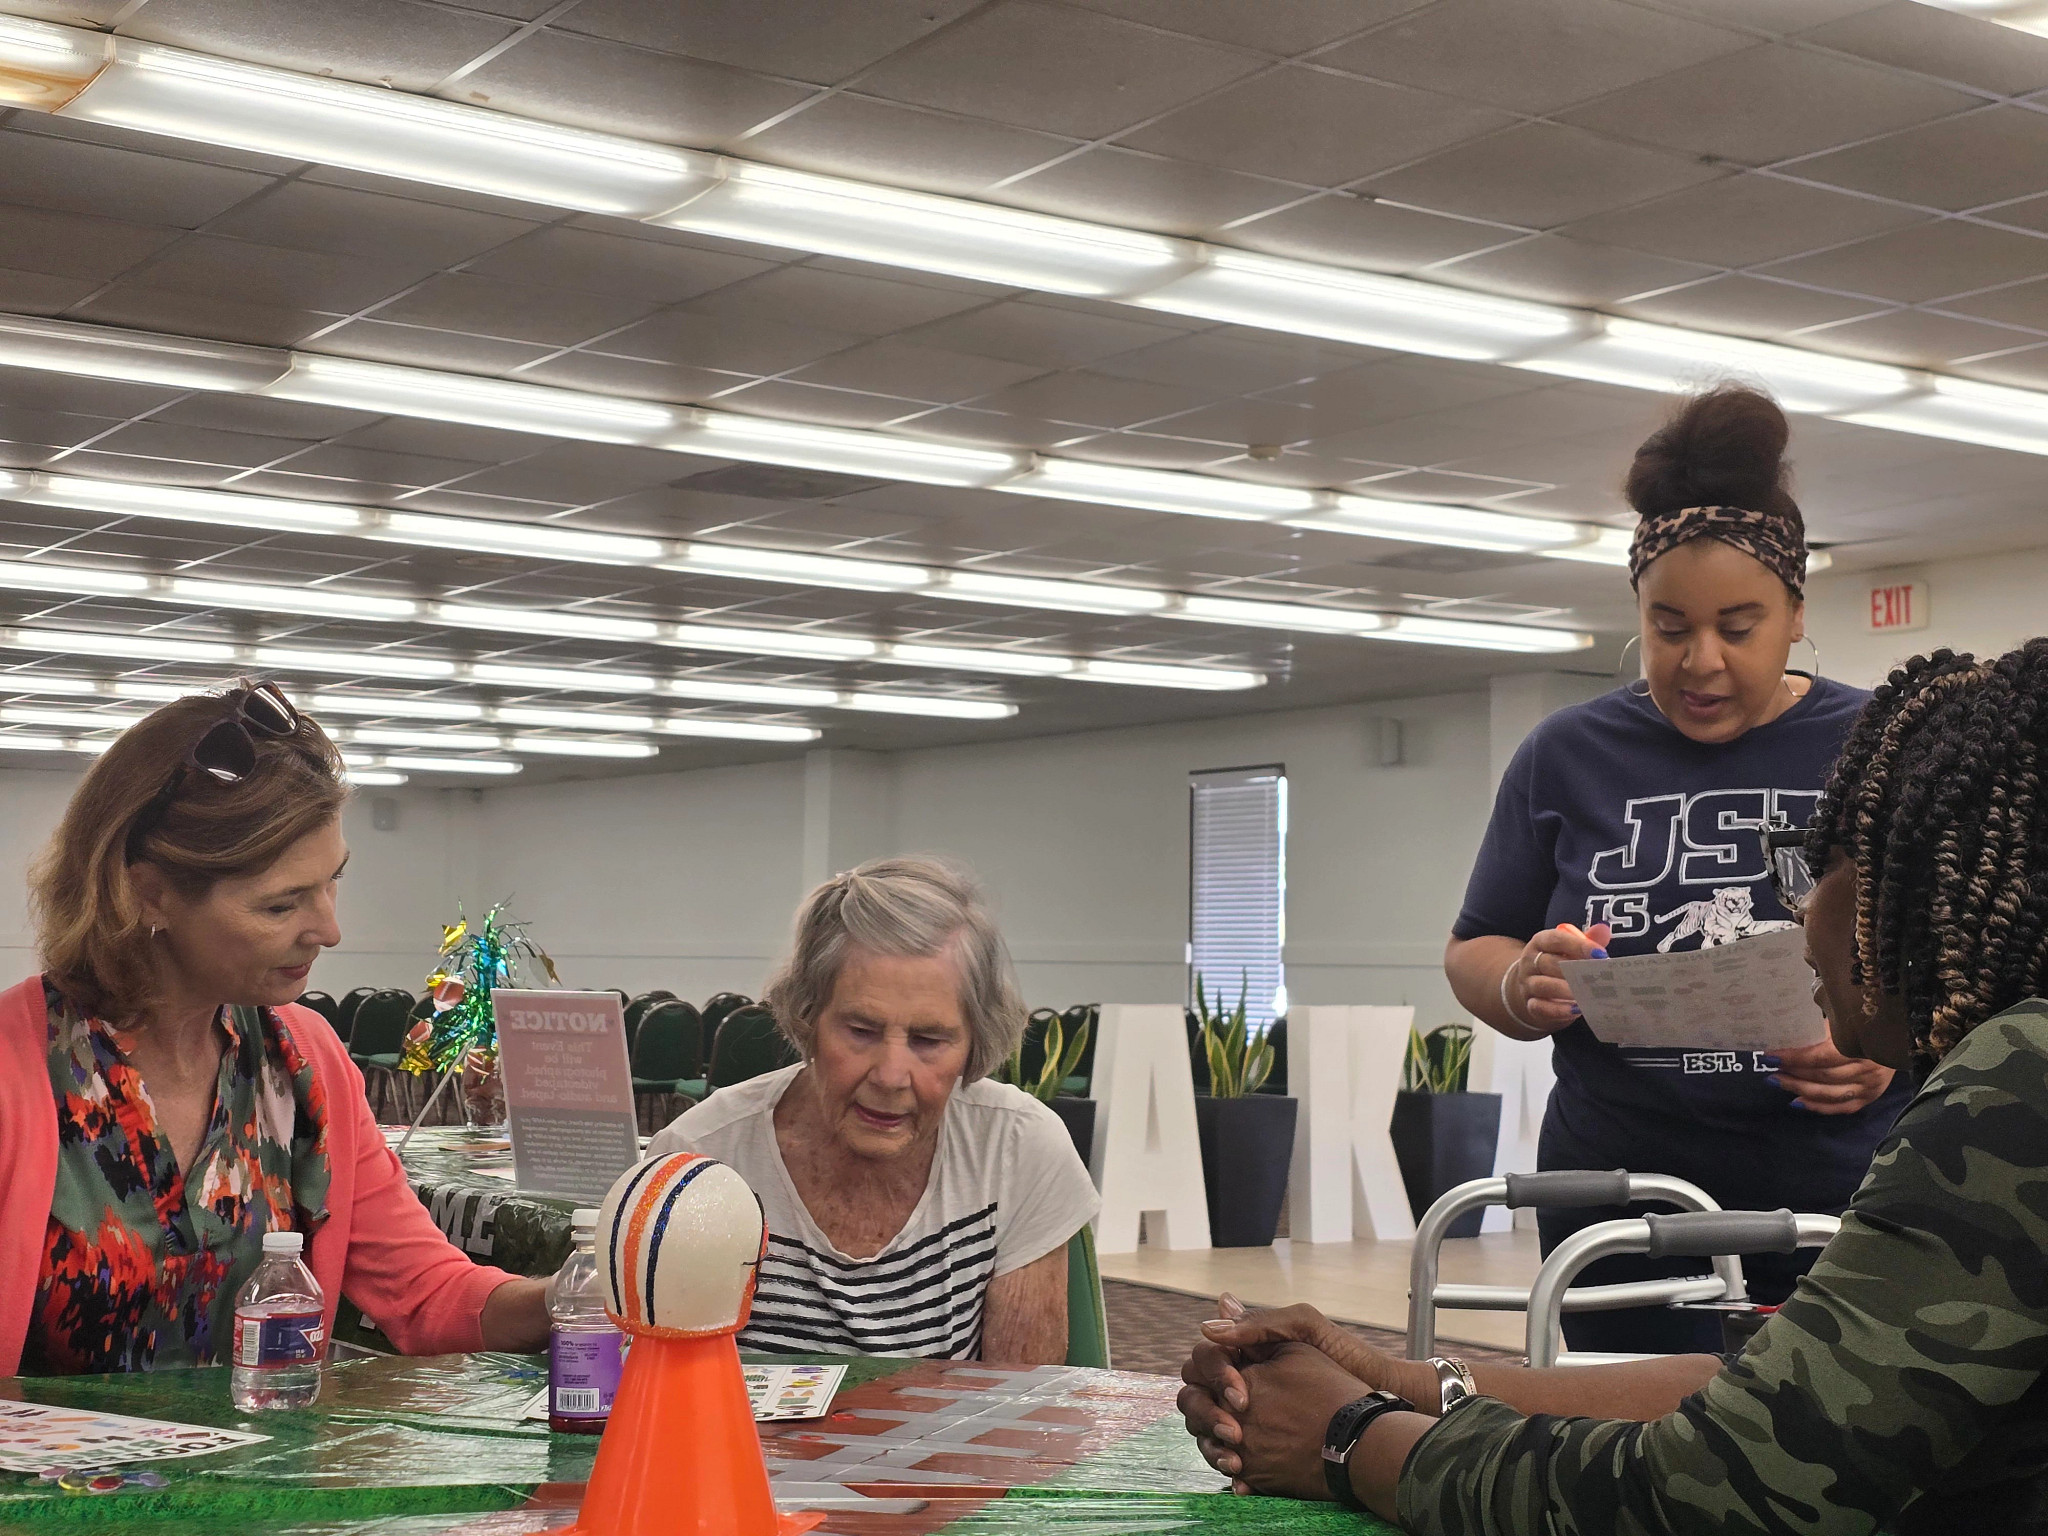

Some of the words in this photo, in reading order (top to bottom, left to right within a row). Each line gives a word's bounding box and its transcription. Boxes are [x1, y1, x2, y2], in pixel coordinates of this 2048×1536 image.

[1871, 584, 1913, 627] EXIT
[1683, 1052, 1743, 1074] EST.
[408, 1180, 497, 1257] ME
